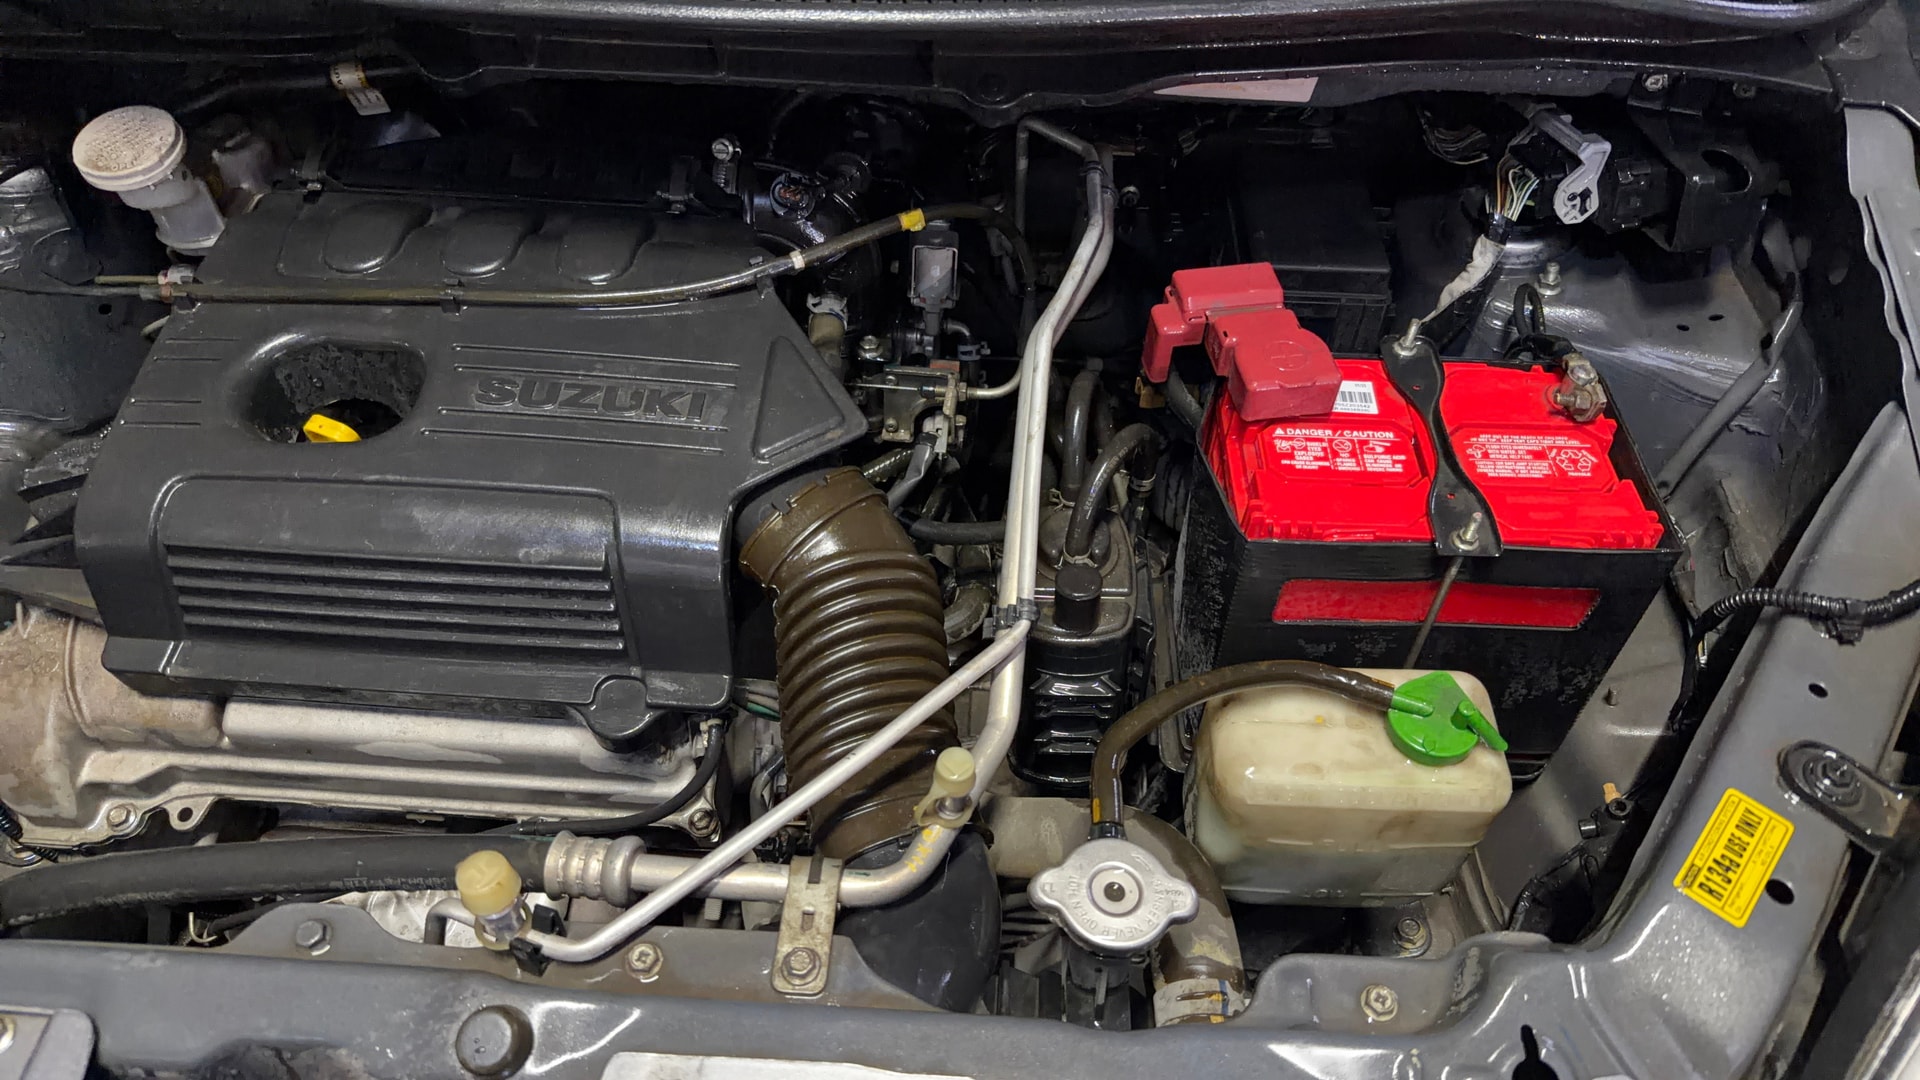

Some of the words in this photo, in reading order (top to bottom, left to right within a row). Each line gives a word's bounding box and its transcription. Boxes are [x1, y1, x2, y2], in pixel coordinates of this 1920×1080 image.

[475, 376, 706, 422] SUZUKI
[1286, 428, 1333, 437] DANGER
[1343, 430, 1394, 439] CAUTION
[1733, 806, 1765, 839] ONLY
[1722, 832, 1751, 860] USE
[1696, 850, 1743, 903] R134a
[1072, 899, 1098, 930] OPEN
[1101, 924, 1145, 939] NEVER
